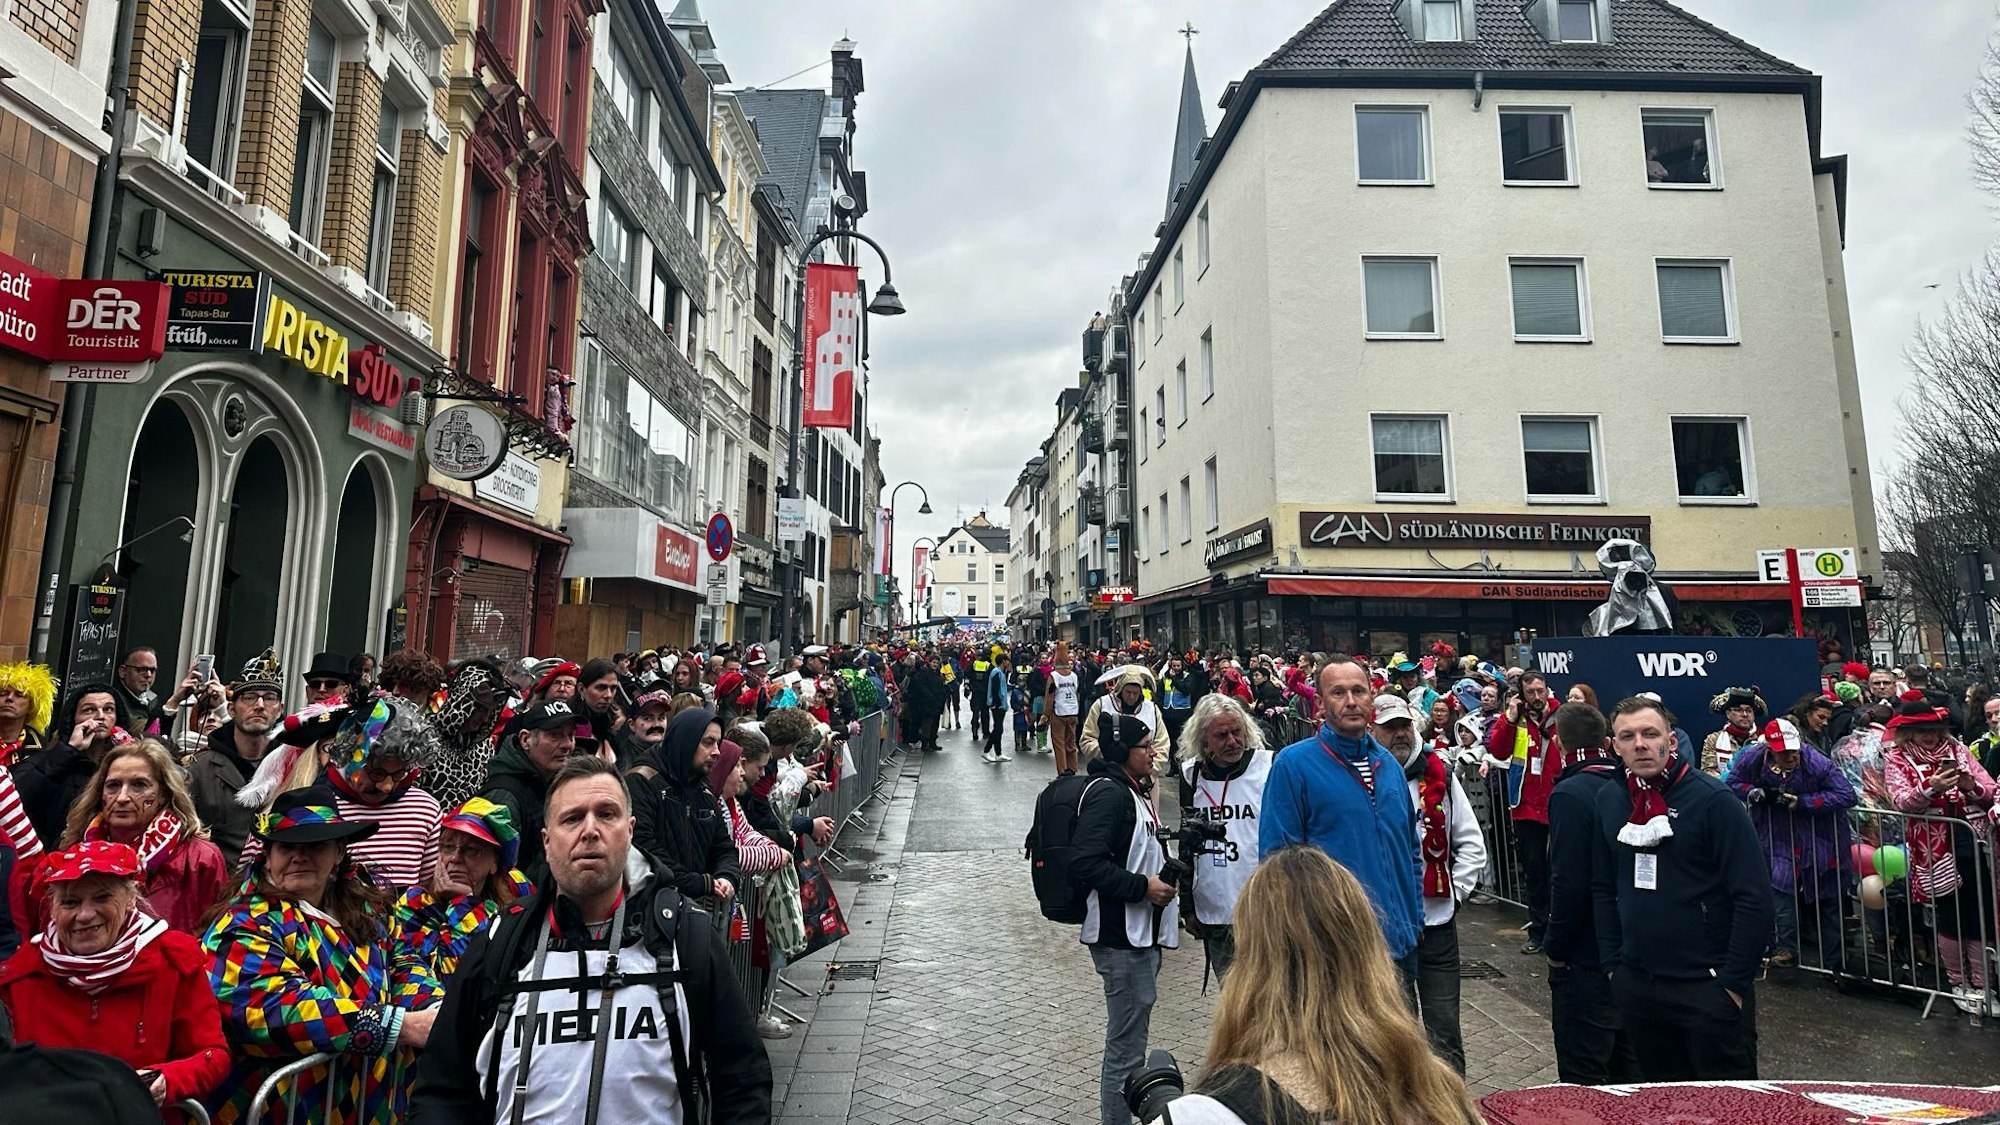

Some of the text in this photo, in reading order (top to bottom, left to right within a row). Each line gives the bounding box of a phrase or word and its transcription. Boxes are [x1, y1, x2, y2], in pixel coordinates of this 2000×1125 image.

[0, 269, 32, 302] adt
[163, 273, 254, 289] TURISTA
[184, 287, 228, 305] SÜD
[67, 297, 141, 331] DER
[180, 308, 230, 319] Tapas-Bar
[67, 334, 140, 349] Touristik
[209, 338, 239, 346] KÖLSCH
[67, 366, 130, 380] Partner
[355, 346, 404, 408] SÜD
[1310, 513, 1643, 545] CAN SÜDLÄNDISCHE FEINKOST
[1764, 559, 1781, 580] E
[1822, 557, 1837, 572] H
[1101, 586, 1133, 595] KIOSK
[1112, 594, 1124, 602] 46
[1481, 586, 1605, 598] CAN Südländische
[1537, 651, 1569, 674] WDR
[1636, 652, 1708, 677] WDR
